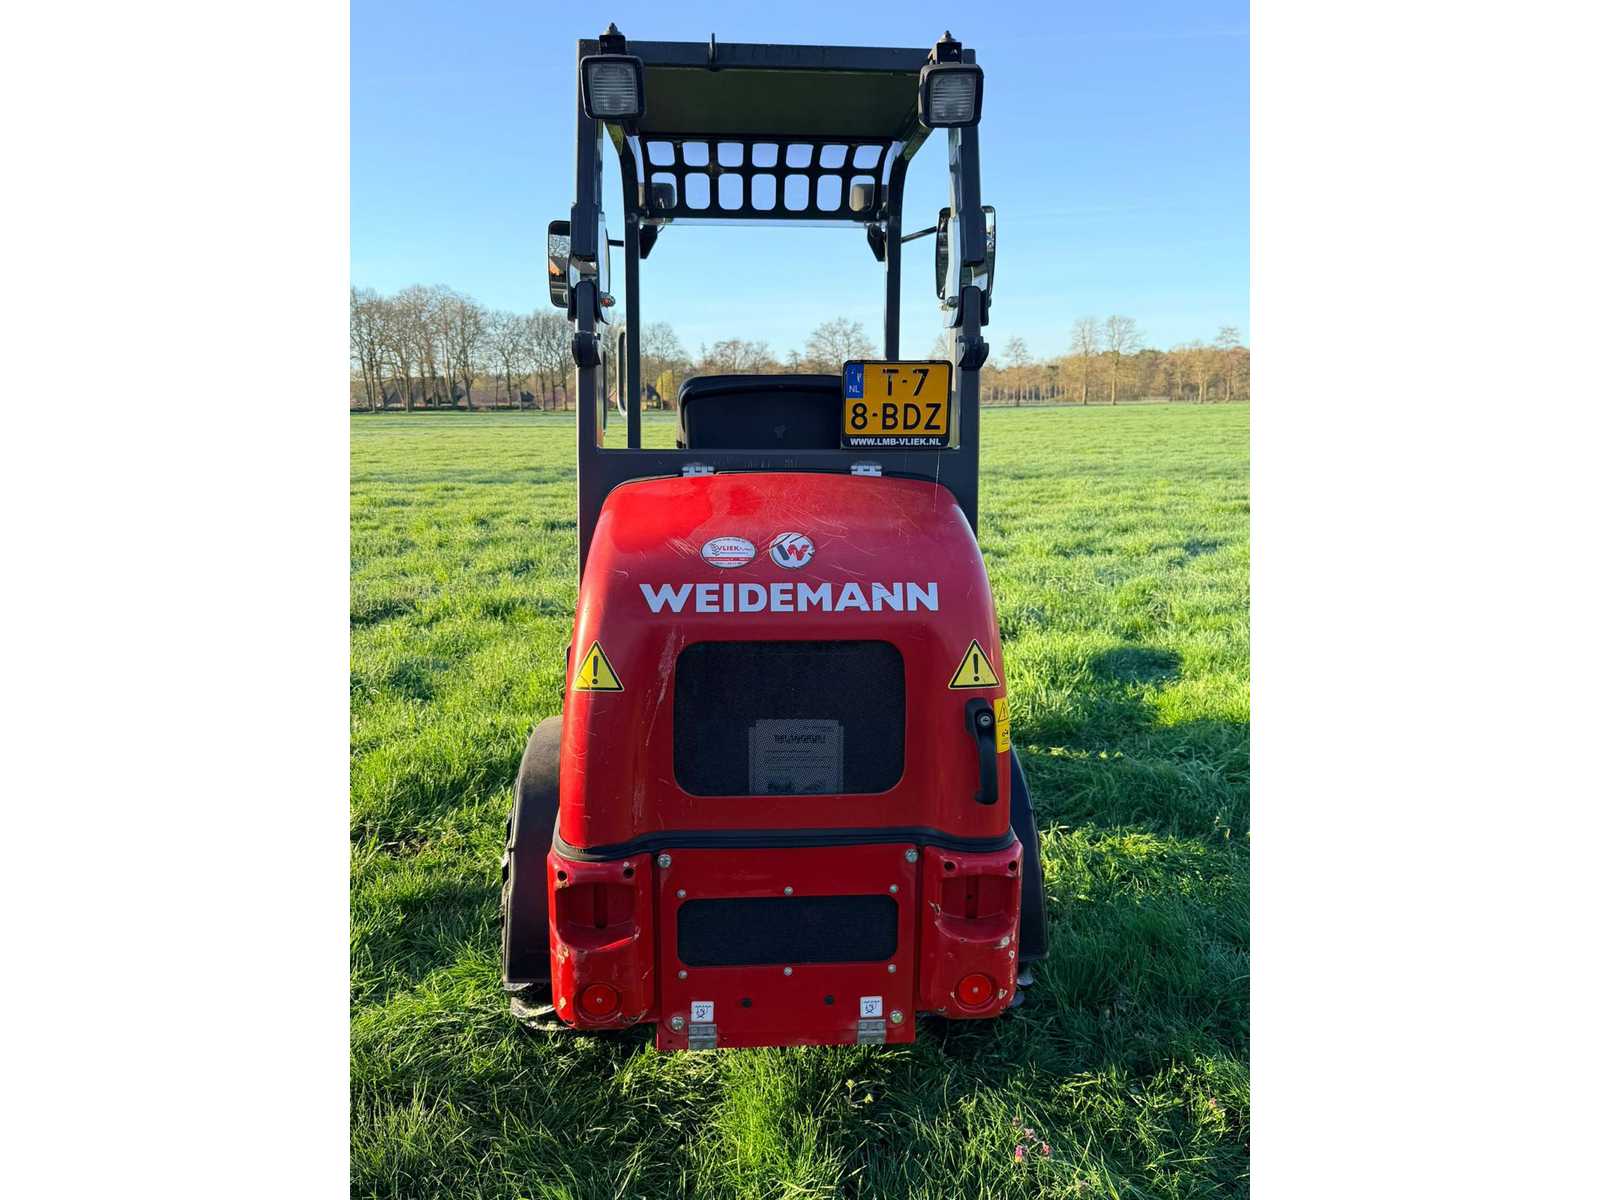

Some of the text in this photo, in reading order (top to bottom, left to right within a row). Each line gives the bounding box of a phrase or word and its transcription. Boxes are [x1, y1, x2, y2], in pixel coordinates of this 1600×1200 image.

[848, 385, 860, 393] NL
[883, 368, 930, 396] T-7
[851, 403, 942, 430] 8-BDZ
[850, 438, 942, 446] WWW.LMB-VLIEK.NL
[639, 582, 939, 613] WEIDEMANN
